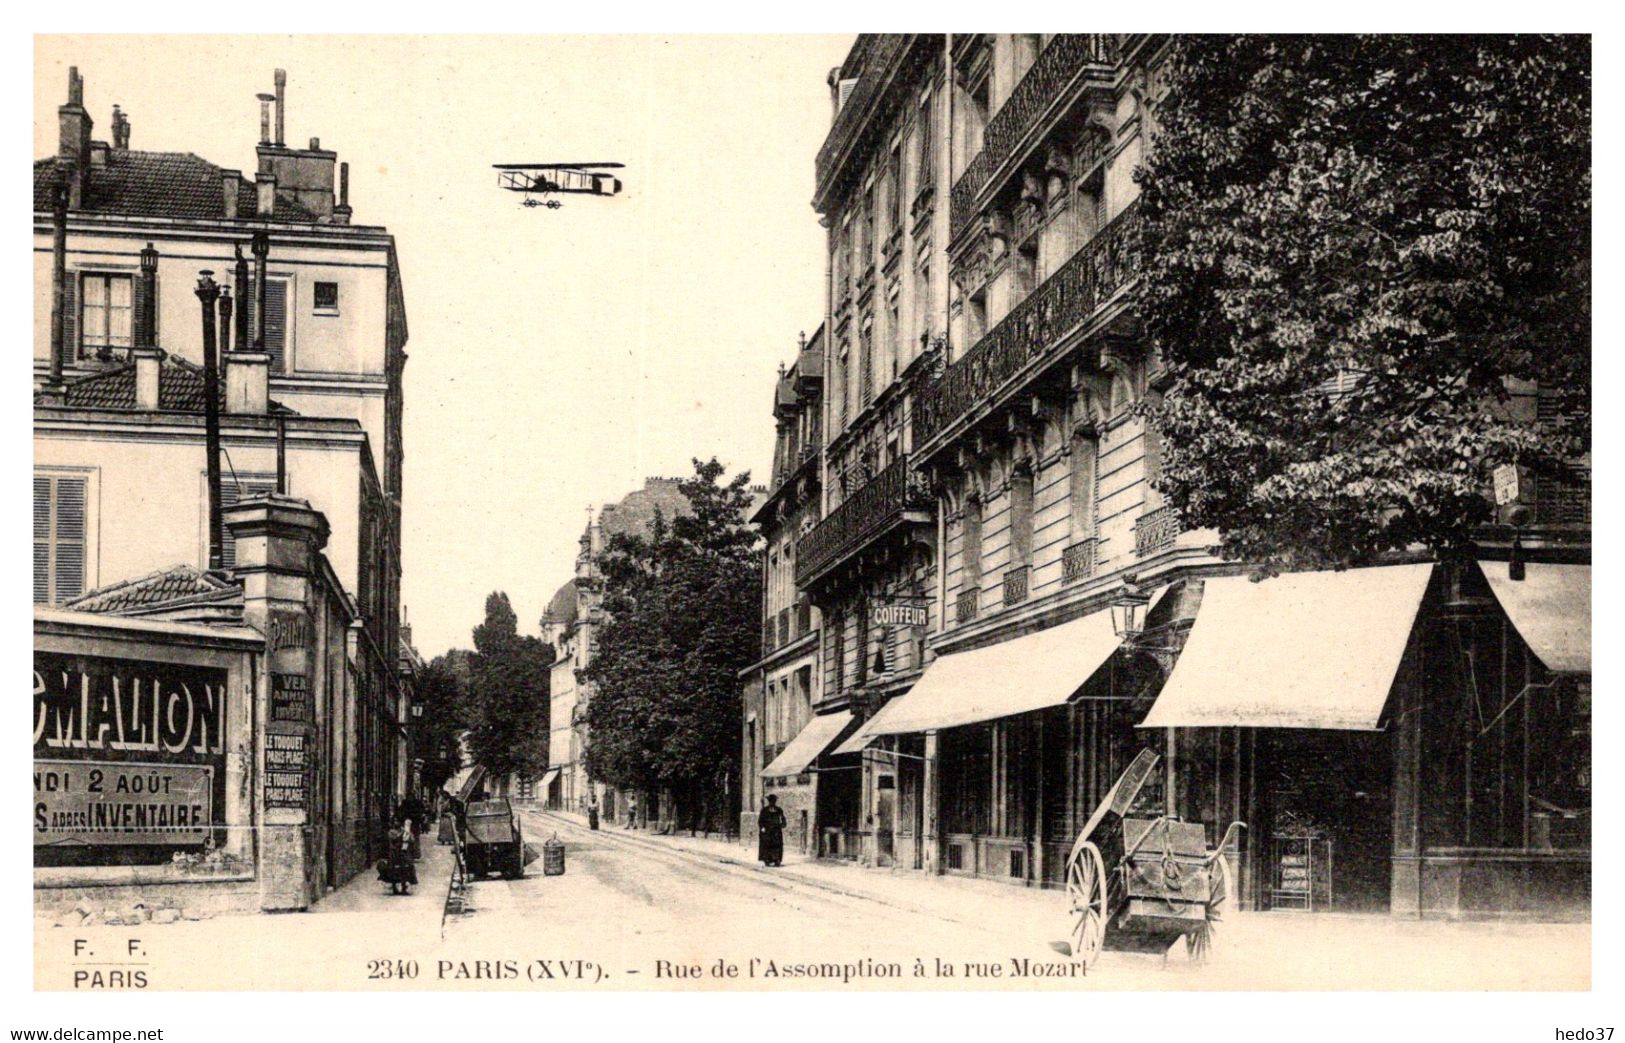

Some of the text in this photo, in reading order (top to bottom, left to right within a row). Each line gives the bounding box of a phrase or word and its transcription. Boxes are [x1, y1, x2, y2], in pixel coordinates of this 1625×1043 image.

[874, 606, 927, 625] COIFFEUR
[264, 735, 273, 749] LE
[87, 768, 104, 793] 2
[115, 770, 172, 794] AOÛT
[264, 772, 272, 786] LE
[87, 802, 203, 833] INVENTAIRE
